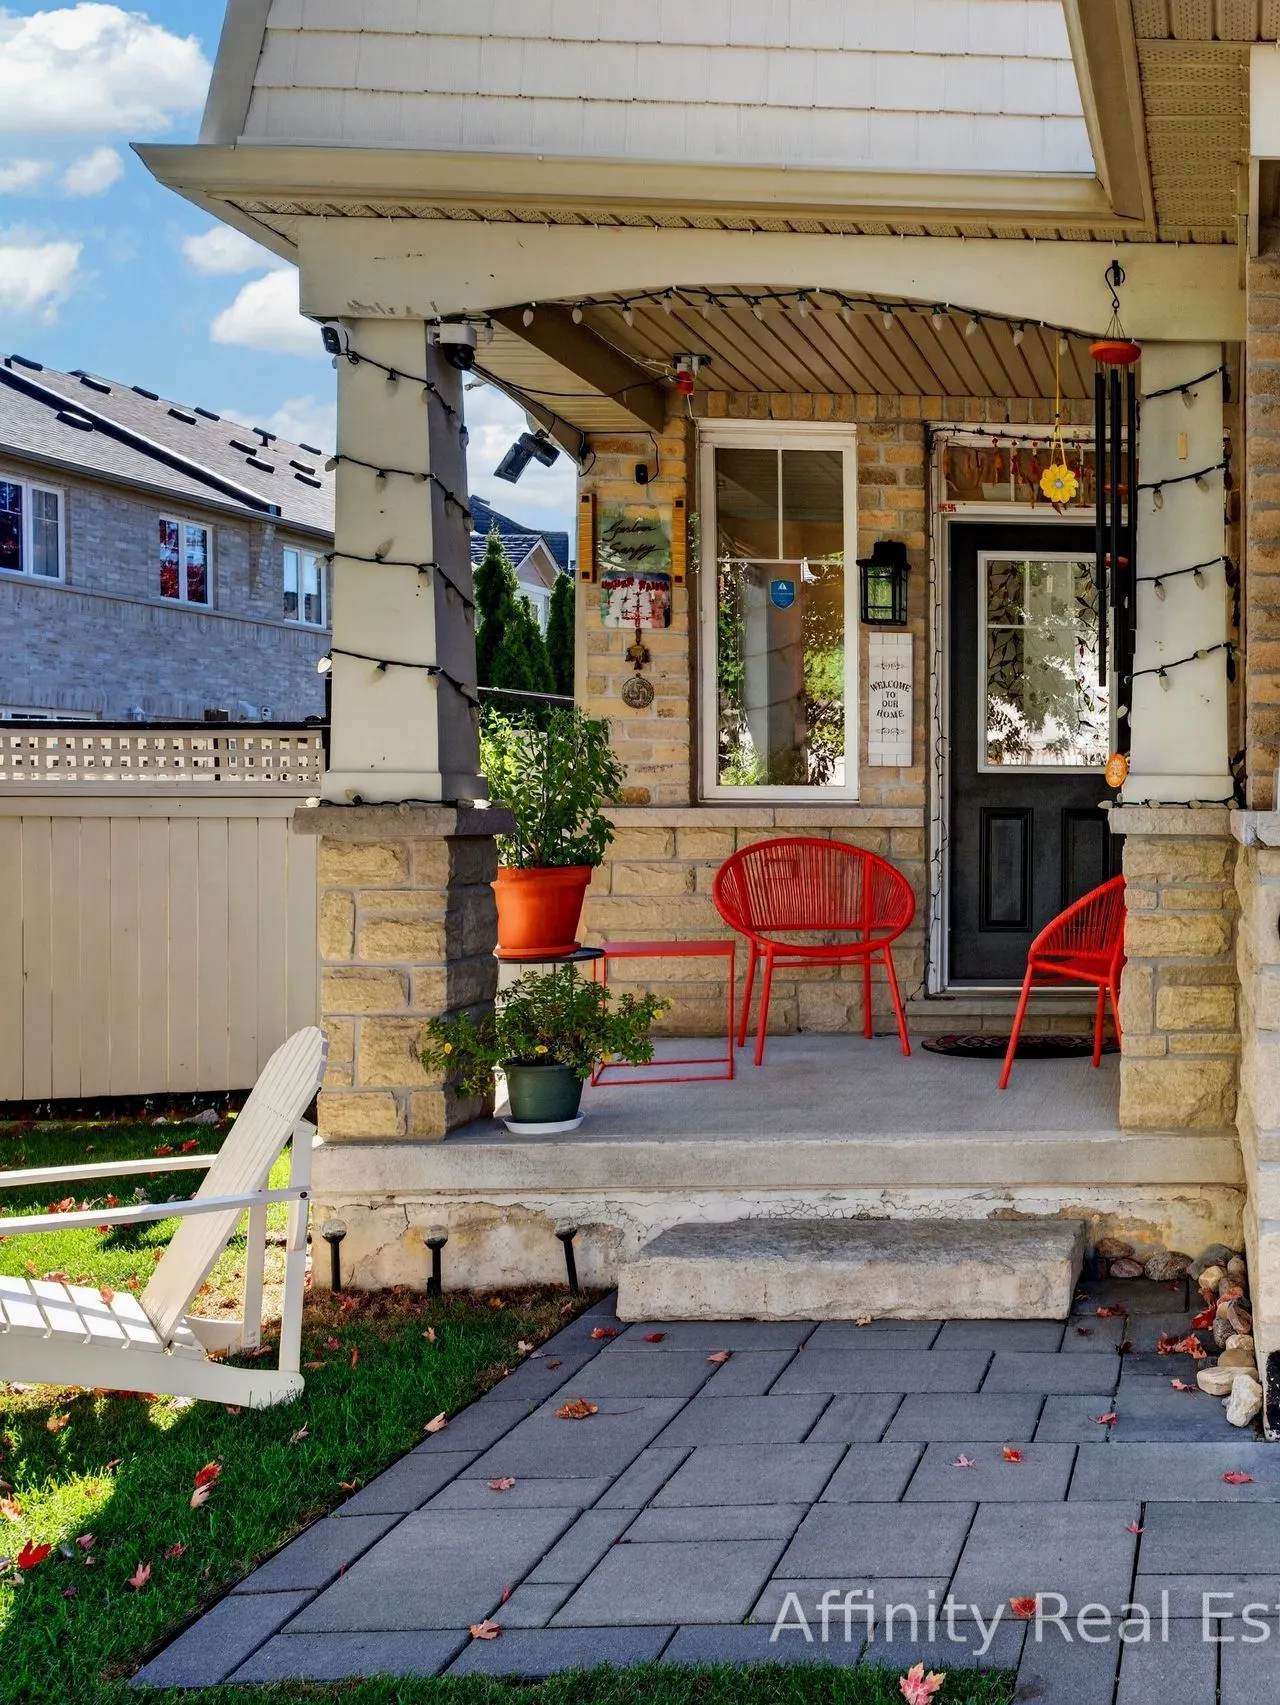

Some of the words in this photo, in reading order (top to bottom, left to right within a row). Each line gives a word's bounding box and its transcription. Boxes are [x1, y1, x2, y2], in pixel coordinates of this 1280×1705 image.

[870, 680, 911, 692] WELCOME
[882, 700, 898, 708] OUR
[877, 709, 905, 718] HOME
